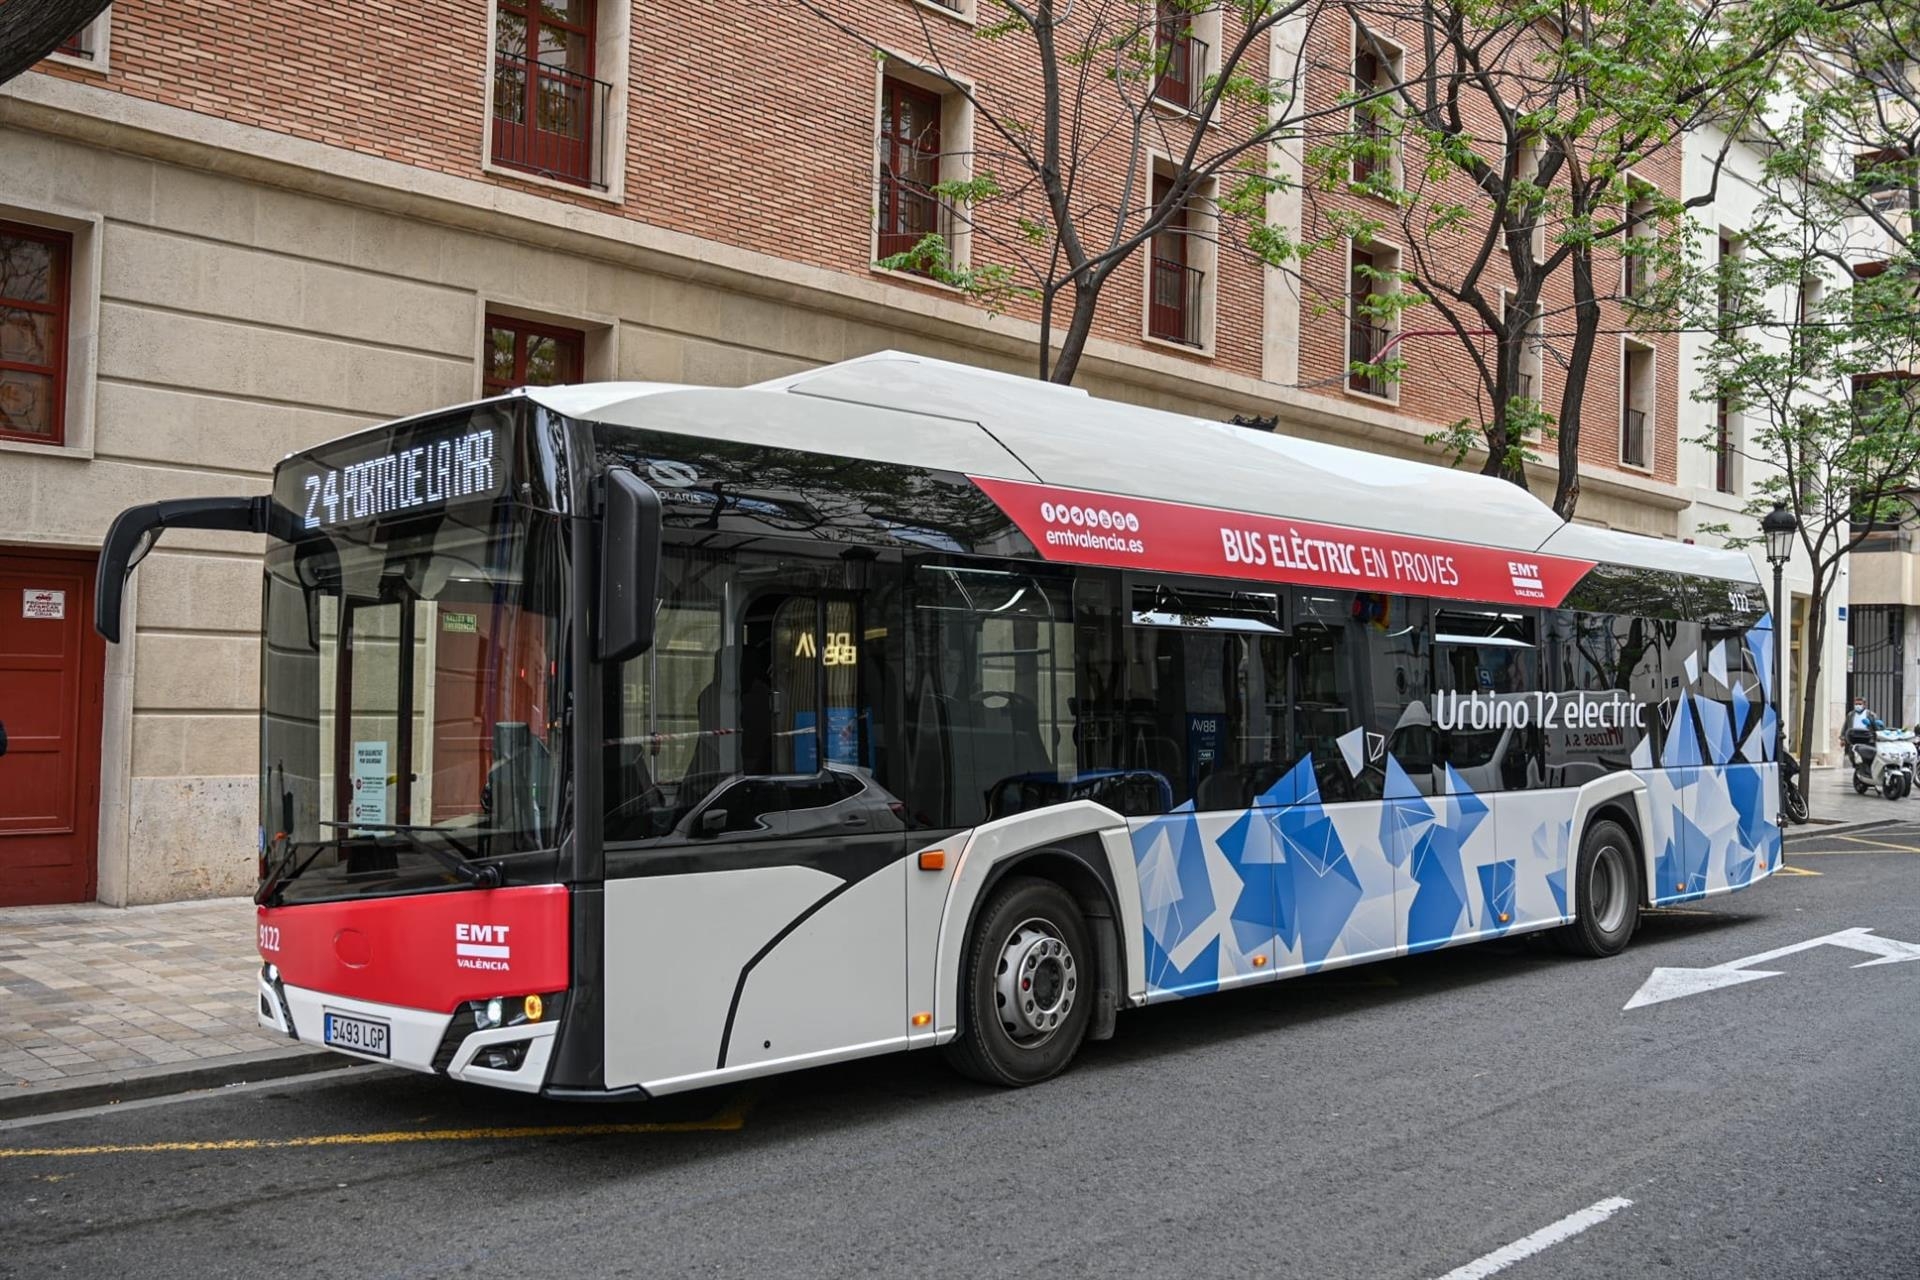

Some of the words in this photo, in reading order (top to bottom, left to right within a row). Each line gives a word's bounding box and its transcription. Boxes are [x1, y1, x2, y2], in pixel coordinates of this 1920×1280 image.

[305, 470, 339, 529] 24
[344, 454, 396, 520] PORTA
[400, 447, 424, 508] DE
[427, 440, 451, 502] LA
[455, 430, 494, 496] MAR
[658, 490, 702, 504] OLARIS
[1046, 529, 1144, 554] emtvalencia.es
[1220, 528, 1267, 565] BUS
[1268, 528, 1360, 576] ELÈCTRIC
[1360, 546, 1389, 578] EN
[1391, 550, 1459, 586] PROVES
[1508, 561, 1538, 578] EMT
[1728, 592, 1751, 613] 9122
[1437, 689, 1529, 730] Urbino
[1534, 691, 1558, 728] 12
[1564, 692, 1647, 728] electric
[260, 924, 280, 951] 9122
[456, 923, 510, 944] EMT
[457, 957, 510, 971] VALÈNCIA
[333, 1019, 360, 1045] 5493
[363, 1025, 385, 1049] LGP
